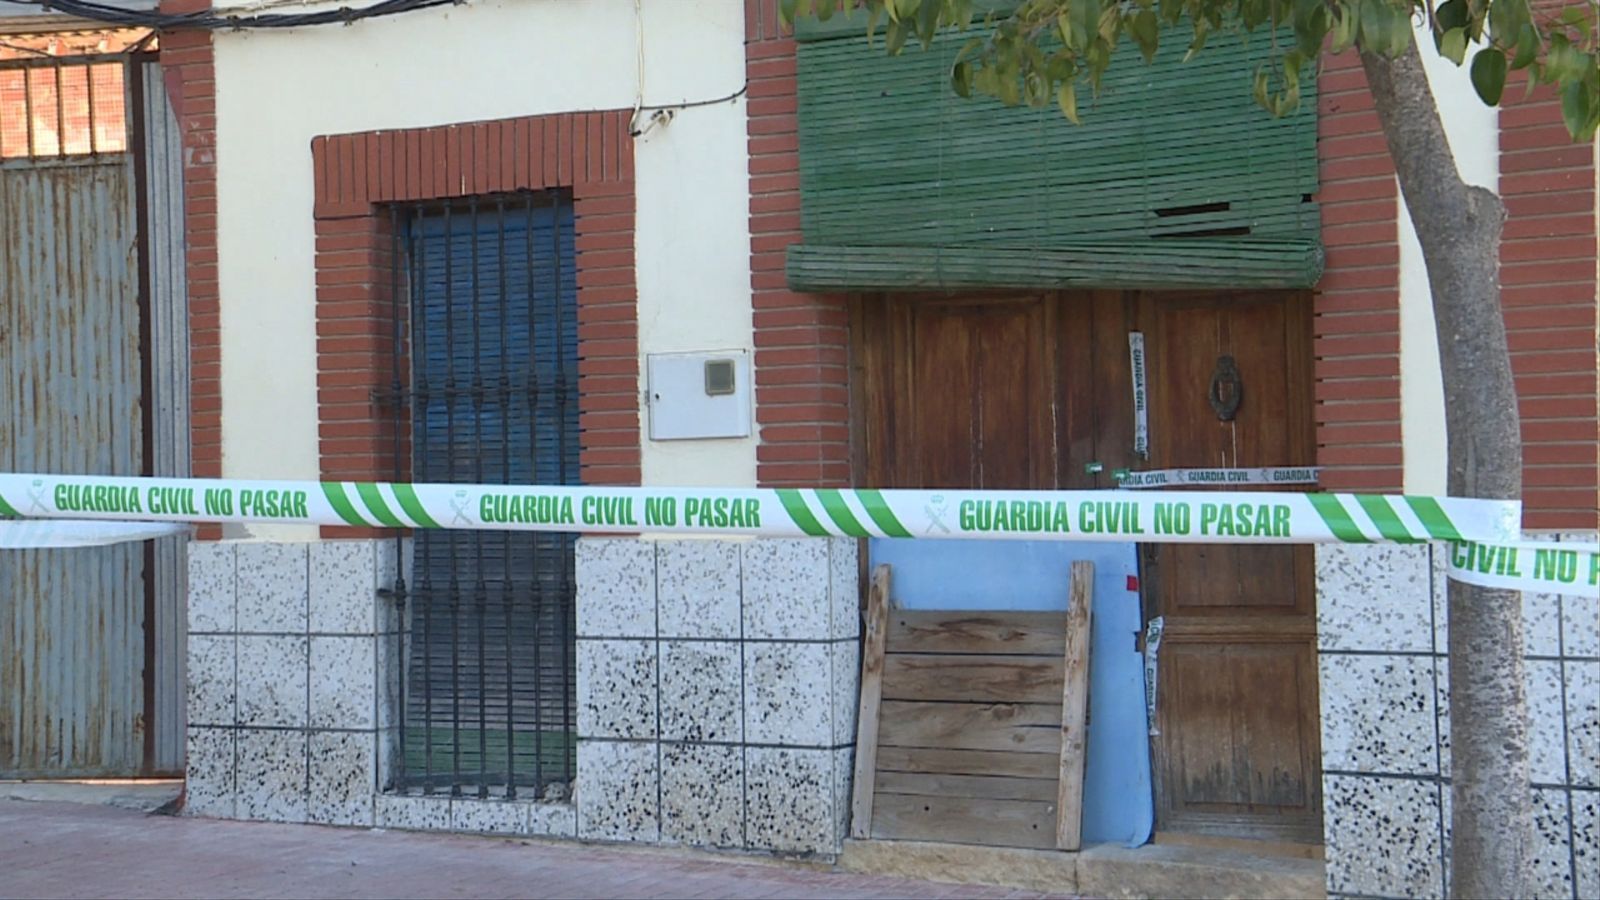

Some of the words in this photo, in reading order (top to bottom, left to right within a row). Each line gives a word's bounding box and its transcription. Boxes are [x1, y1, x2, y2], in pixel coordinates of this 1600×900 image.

[1133, 349, 1143, 388] GUARDIA
[1136, 389, 1145, 413] CIVIL
[1145, 473, 1168, 485] CIVIL
[1188, 471, 1226, 482] GUARDIA
[1228, 471, 1249, 481] CIVIL
[1273, 469, 1312, 481] GUARDIA
[54, 483, 143, 513] GUARDIA
[147, 486, 199, 515] CIVIL
[204, 488, 234, 516] NO
[239, 489, 309, 518] PASAR
[479, 493, 575, 525] GUARDIA
[581, 496, 638, 527] CIVIL
[644, 497, 678, 527] NO
[684, 497, 761, 528] PASAR
[959, 499, 1070, 533] GUARDIA
[1078, 500, 1145, 535] CIVIL
[1153, 502, 1191, 535] NO
[1200, 503, 1291, 537] PASAR
[1451, 540, 1522, 578] CIVIL
[1533, 548, 1578, 584] NO
